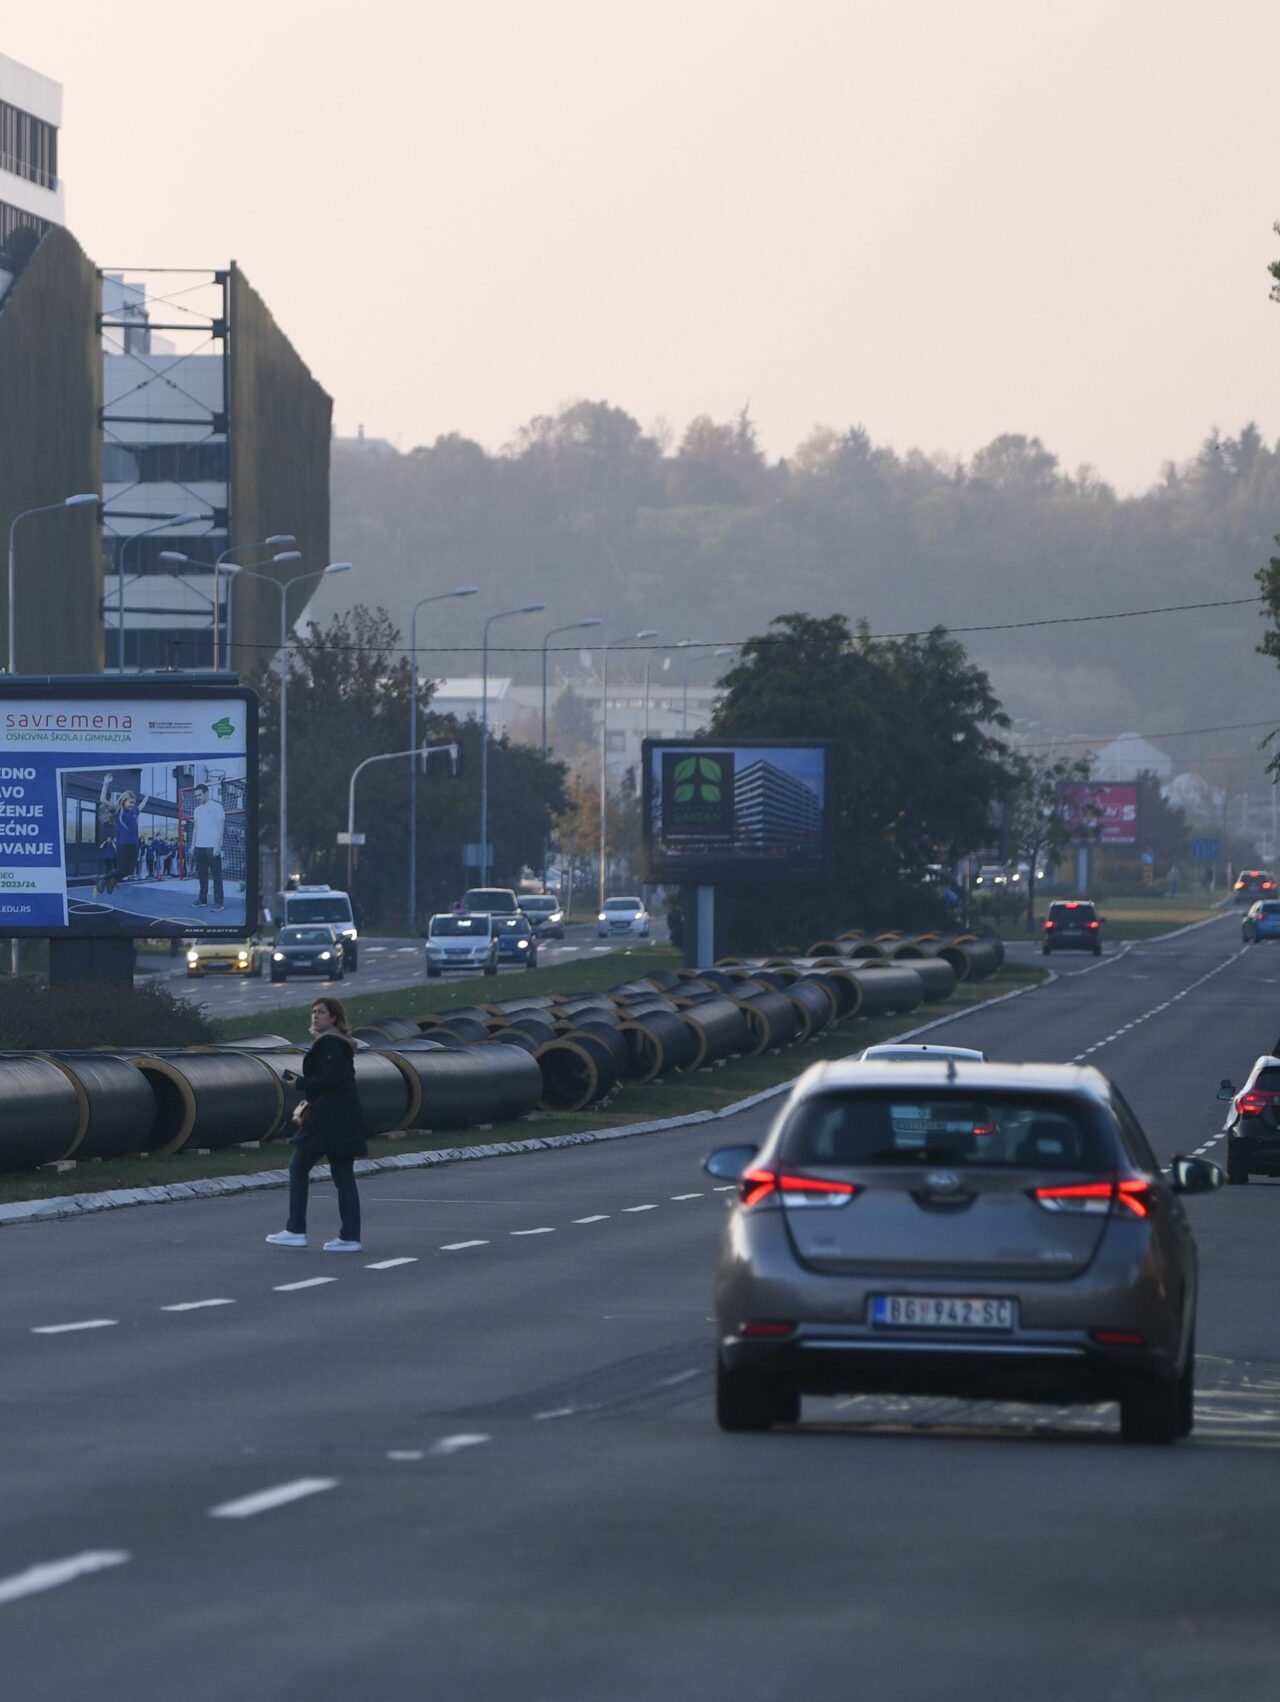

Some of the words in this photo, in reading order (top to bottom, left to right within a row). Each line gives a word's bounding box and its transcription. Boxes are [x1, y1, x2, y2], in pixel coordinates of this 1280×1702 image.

[6, 714, 132, 728] savremena
[6, 732, 48, 741] OSNOVNA
[50, 731, 77, 741] ŠKOLA
[85, 733, 131, 742] GIMNAZIJA
[891, 1301, 916, 1321] BG
